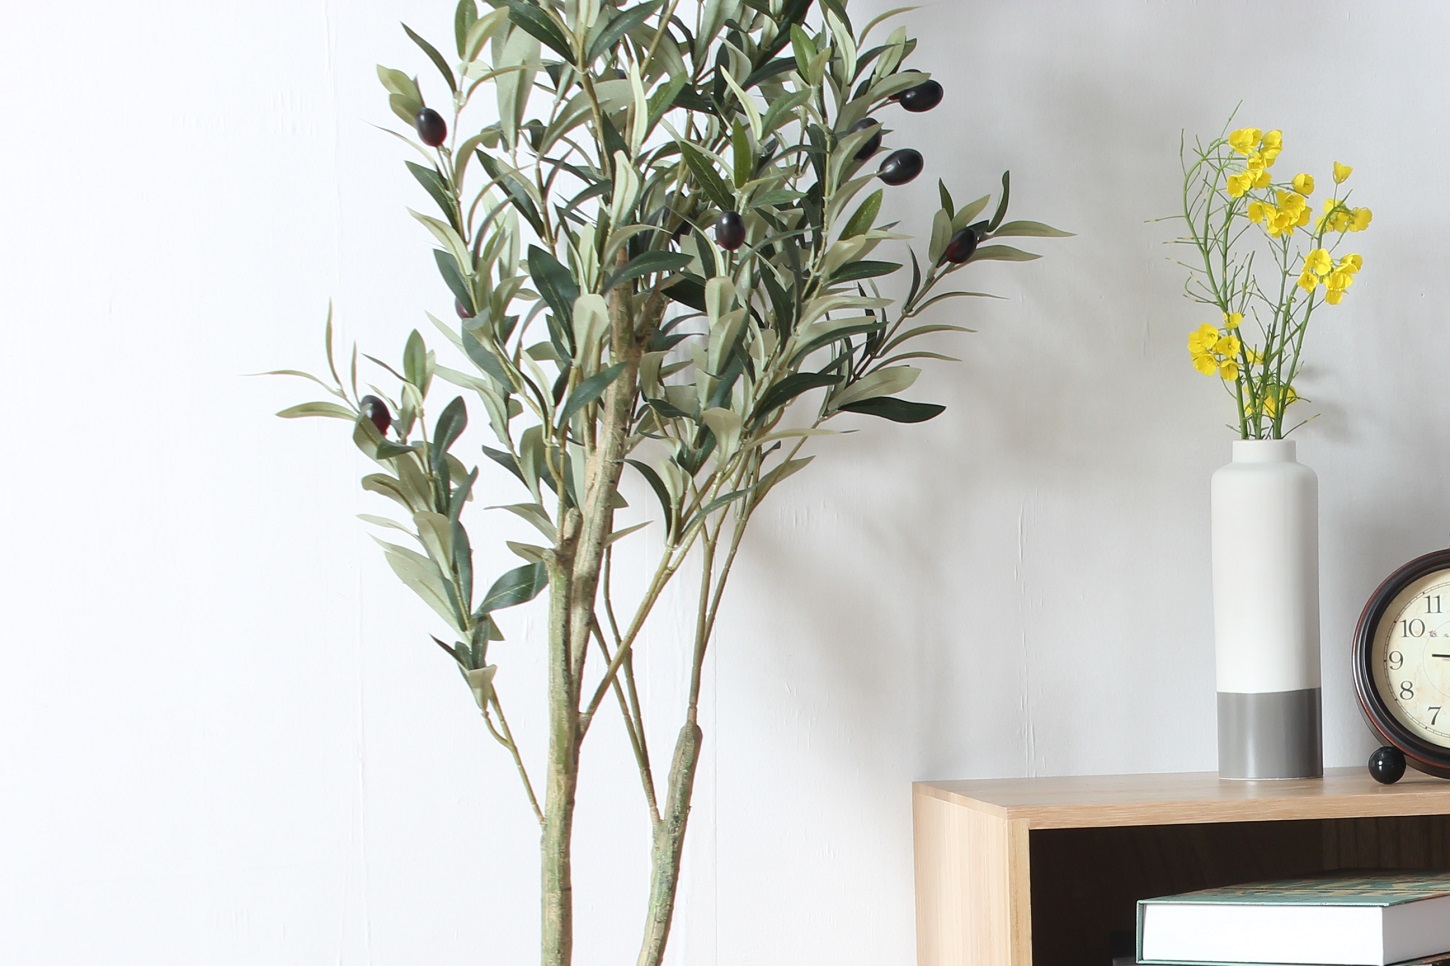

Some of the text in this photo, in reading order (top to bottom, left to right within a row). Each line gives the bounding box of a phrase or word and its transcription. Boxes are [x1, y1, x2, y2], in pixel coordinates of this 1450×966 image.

[1424, 595, 1443, 613] 11
[1400, 618, 1425, 637] 10
[1389, 650, 1403, 670] 9
[1400, 681, 1414, 700] 8
[1428, 707, 1441, 725] 7
